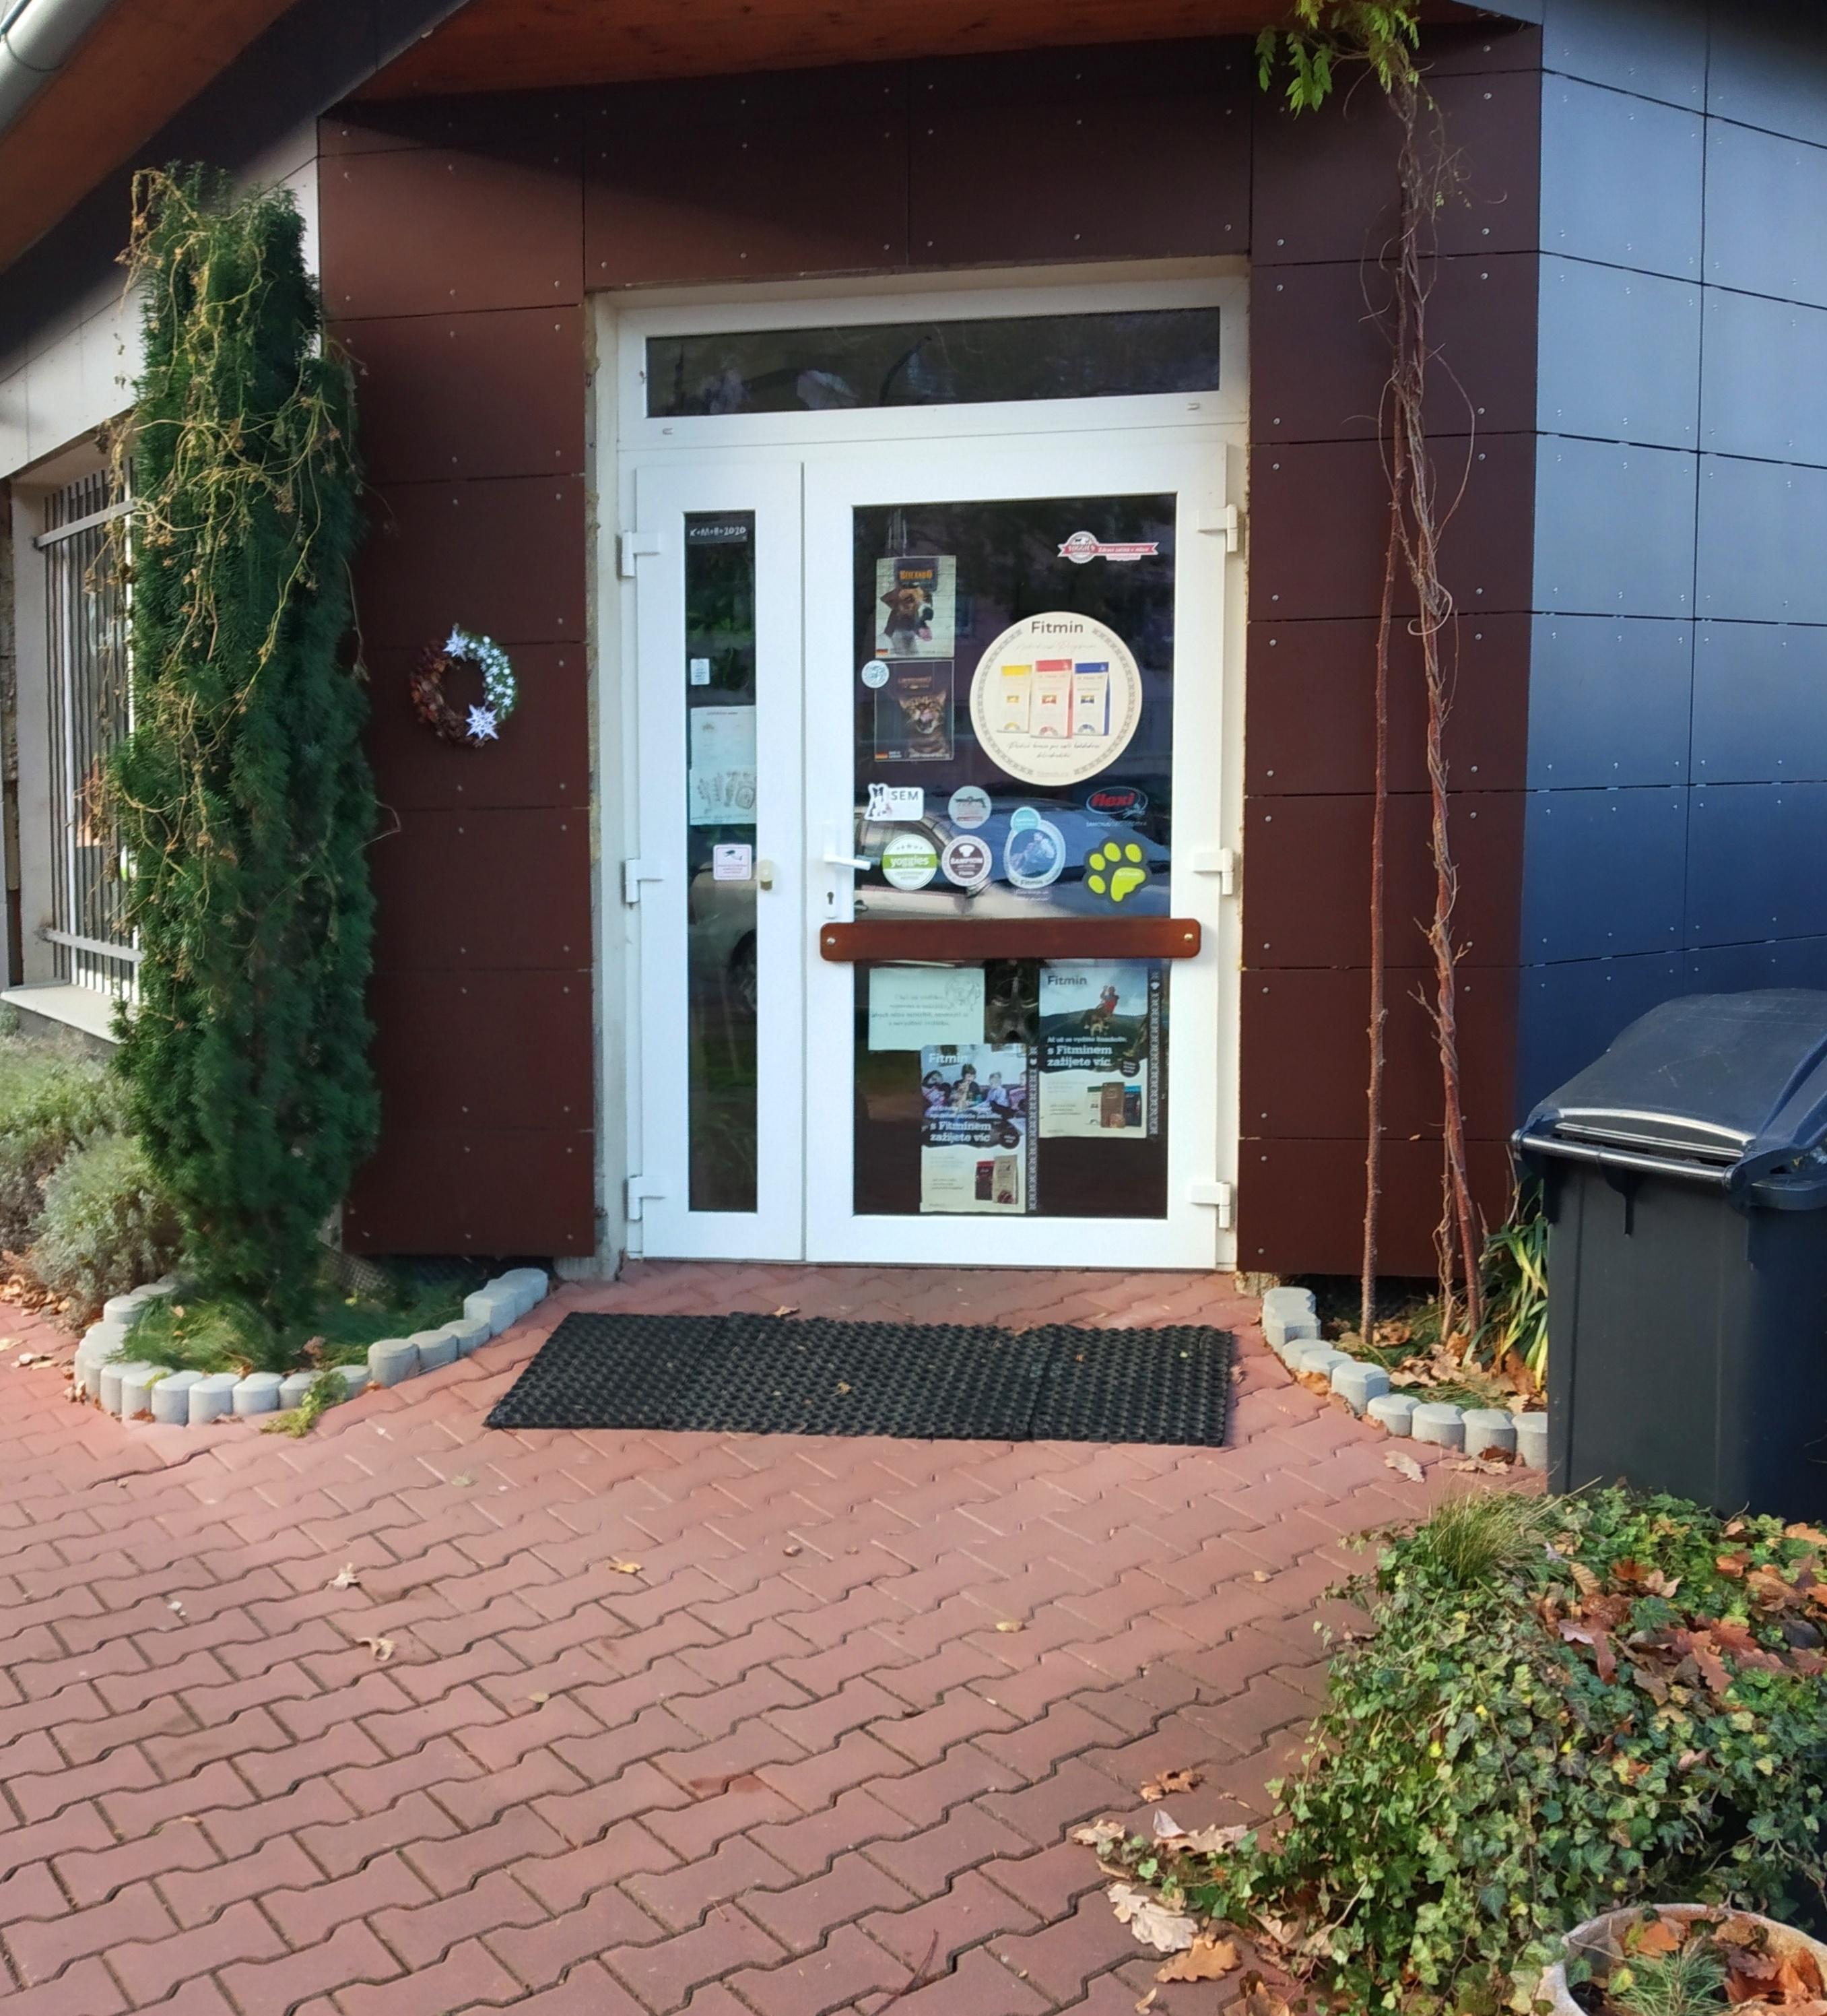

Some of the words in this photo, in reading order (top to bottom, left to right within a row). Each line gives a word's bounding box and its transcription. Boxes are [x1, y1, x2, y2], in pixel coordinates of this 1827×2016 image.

[1031, 620, 1084, 634] Fitmin
[891, 790, 919, 801] SEM
[1047, 975, 1088, 985] Fitmin
[1056, 1045, 1112, 1055] Fitminem
[929, 1053, 968, 1064] Fitmin
[1047, 1056, 1091, 1068] zažijete
[938, 1121, 992, 1131] Fitminem
[930, 1132, 972, 1143] zažijete
[973, 1133, 991, 1142] víc
